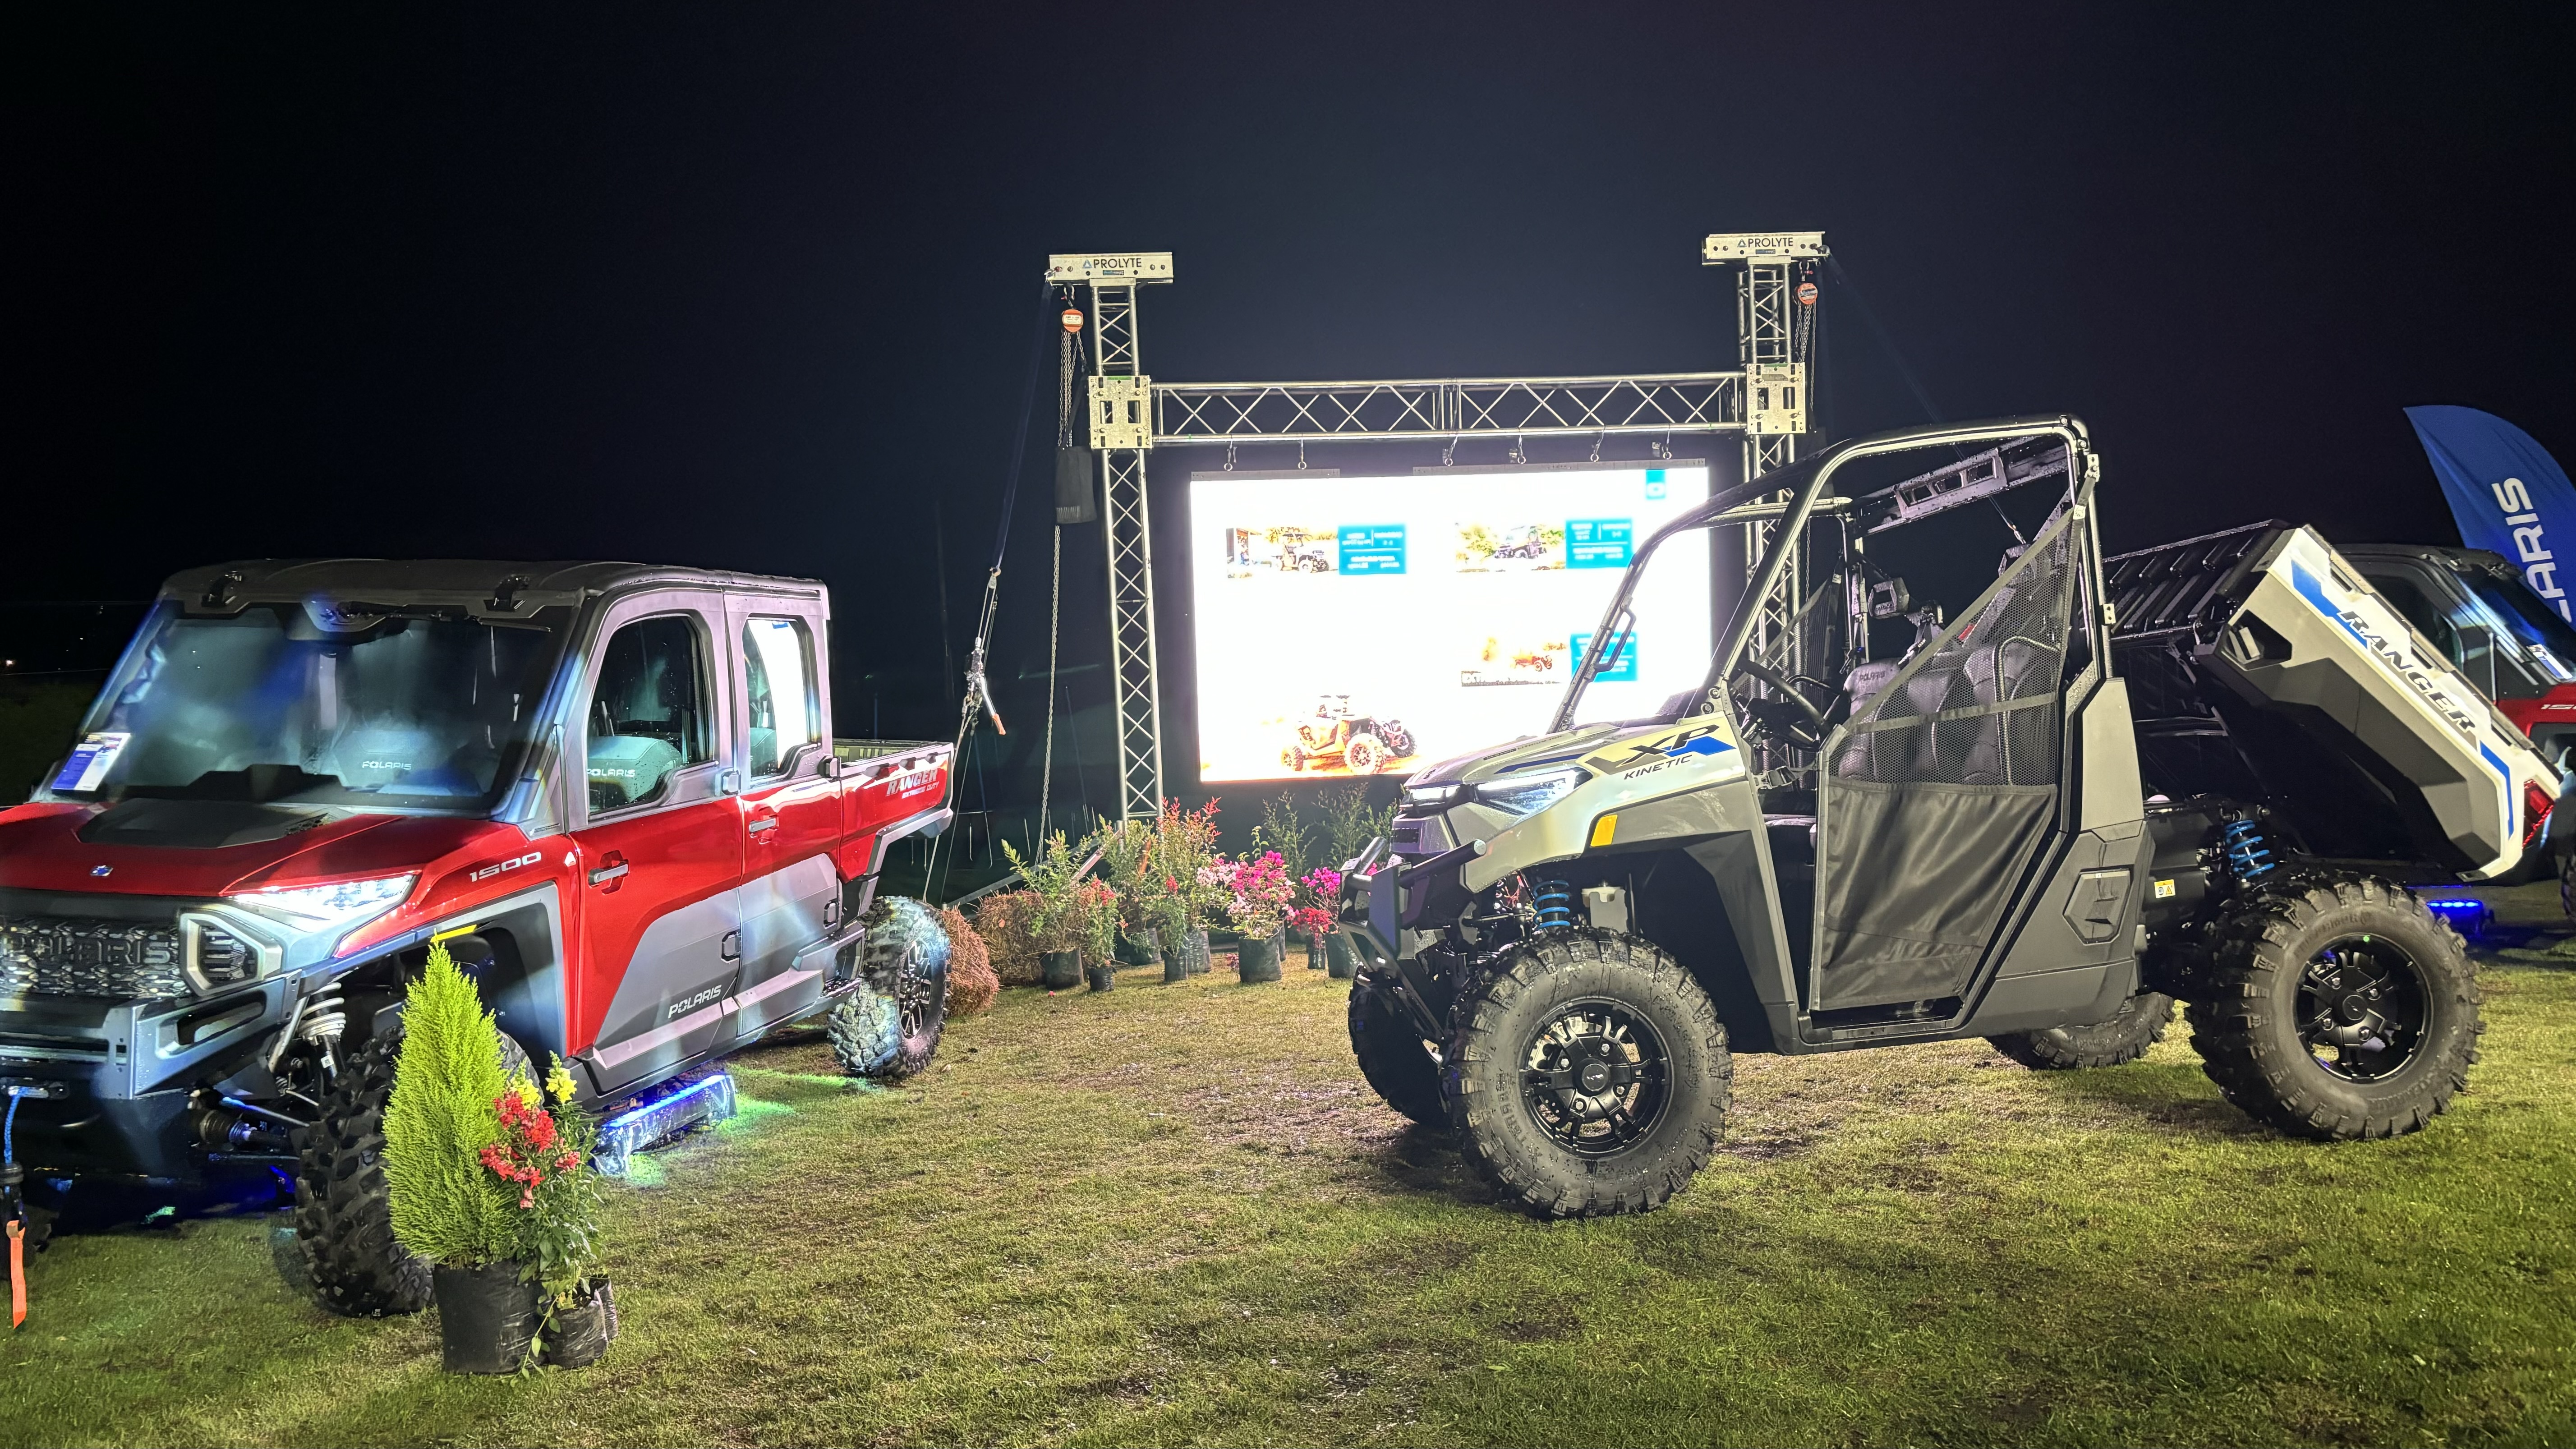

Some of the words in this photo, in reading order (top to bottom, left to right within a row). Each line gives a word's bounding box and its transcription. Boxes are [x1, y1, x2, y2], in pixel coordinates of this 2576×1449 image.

[1748, 237, 1794, 248] PROLYTE
[1094, 258, 1142, 268] PROLYTE
[2340, 611, 2476, 730] RANGER
[1620, 724, 1720, 766] XP
[362, 760, 412, 770] POLARIS
[587, 768, 635, 777] POLARIS
[1624, 754, 1693, 780] KINETIC
[885, 768, 938, 796] RANGER
[469, 851, 542, 882] 1500
[667, 984, 722, 1019] POLARIS
